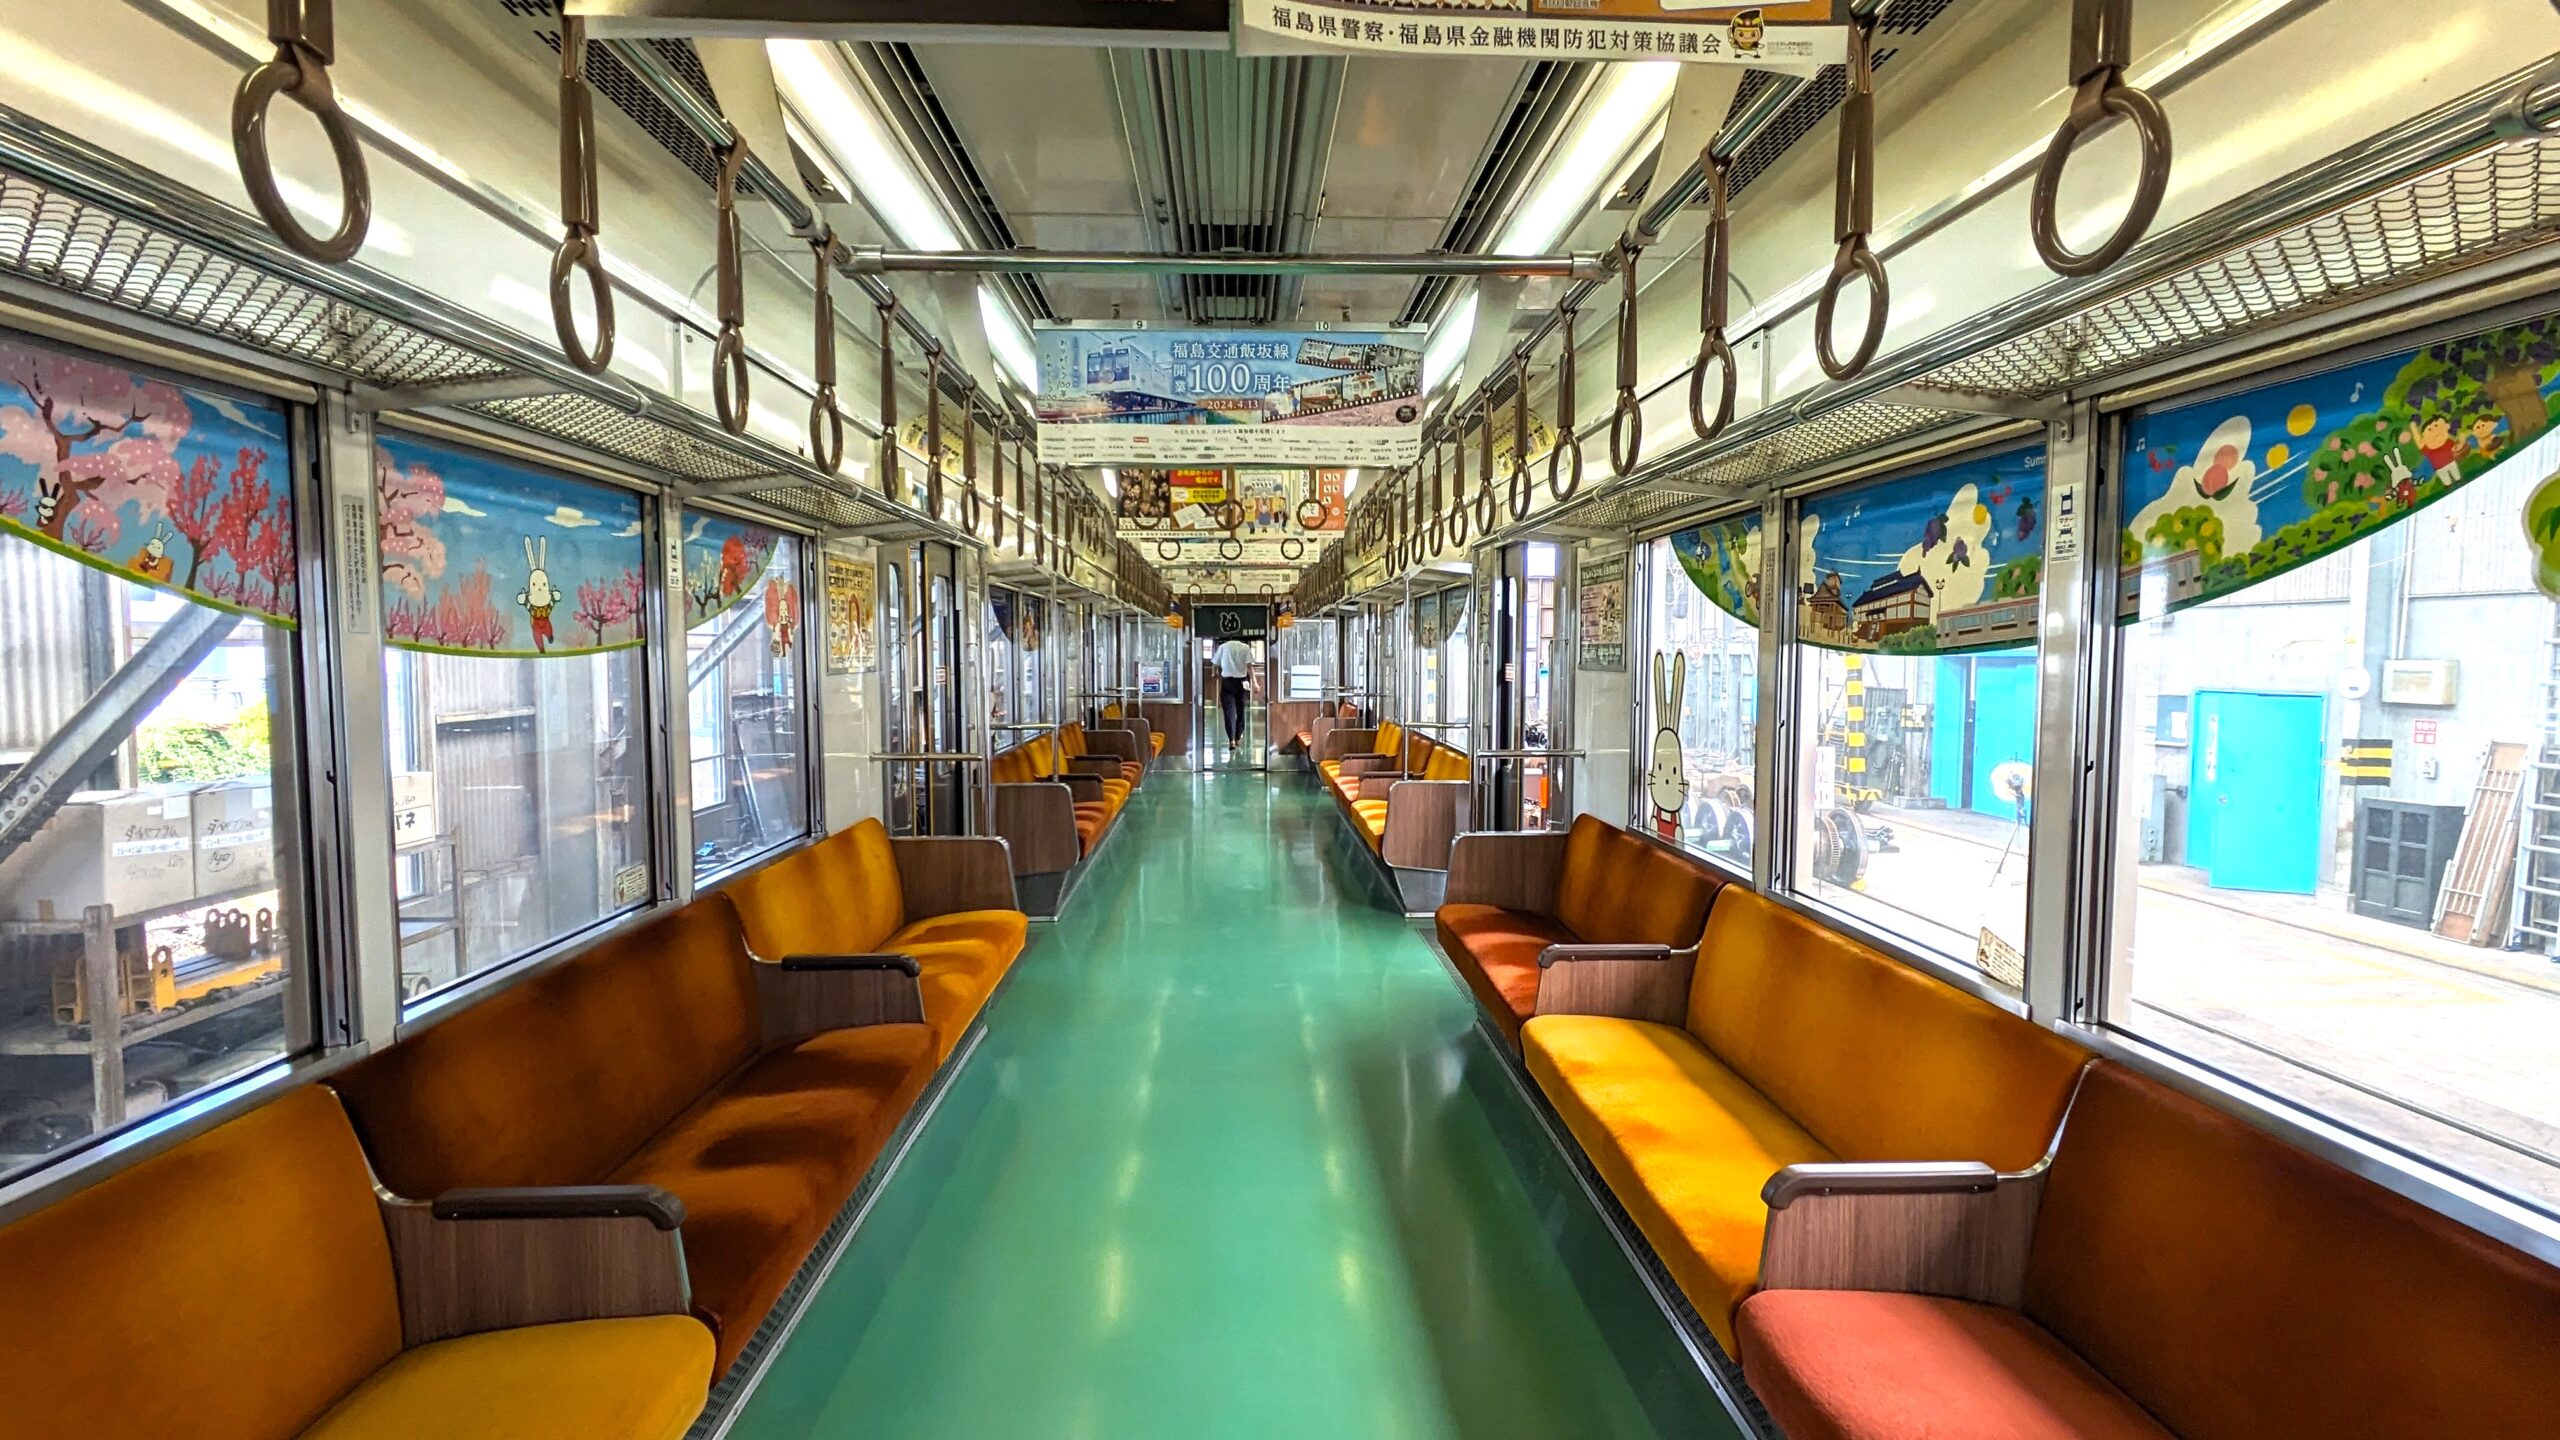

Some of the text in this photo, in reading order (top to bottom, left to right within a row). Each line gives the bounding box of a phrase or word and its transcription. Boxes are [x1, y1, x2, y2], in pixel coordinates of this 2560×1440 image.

[1136, 320, 1143, 329] 9
[1317, 321, 1329, 330] 10
[1172, 341, 1290, 360] 福島交通飯坂線
[1173, 363, 1187, 394] 開業
[1207, 400, 1259, 410] 2024.4.13
